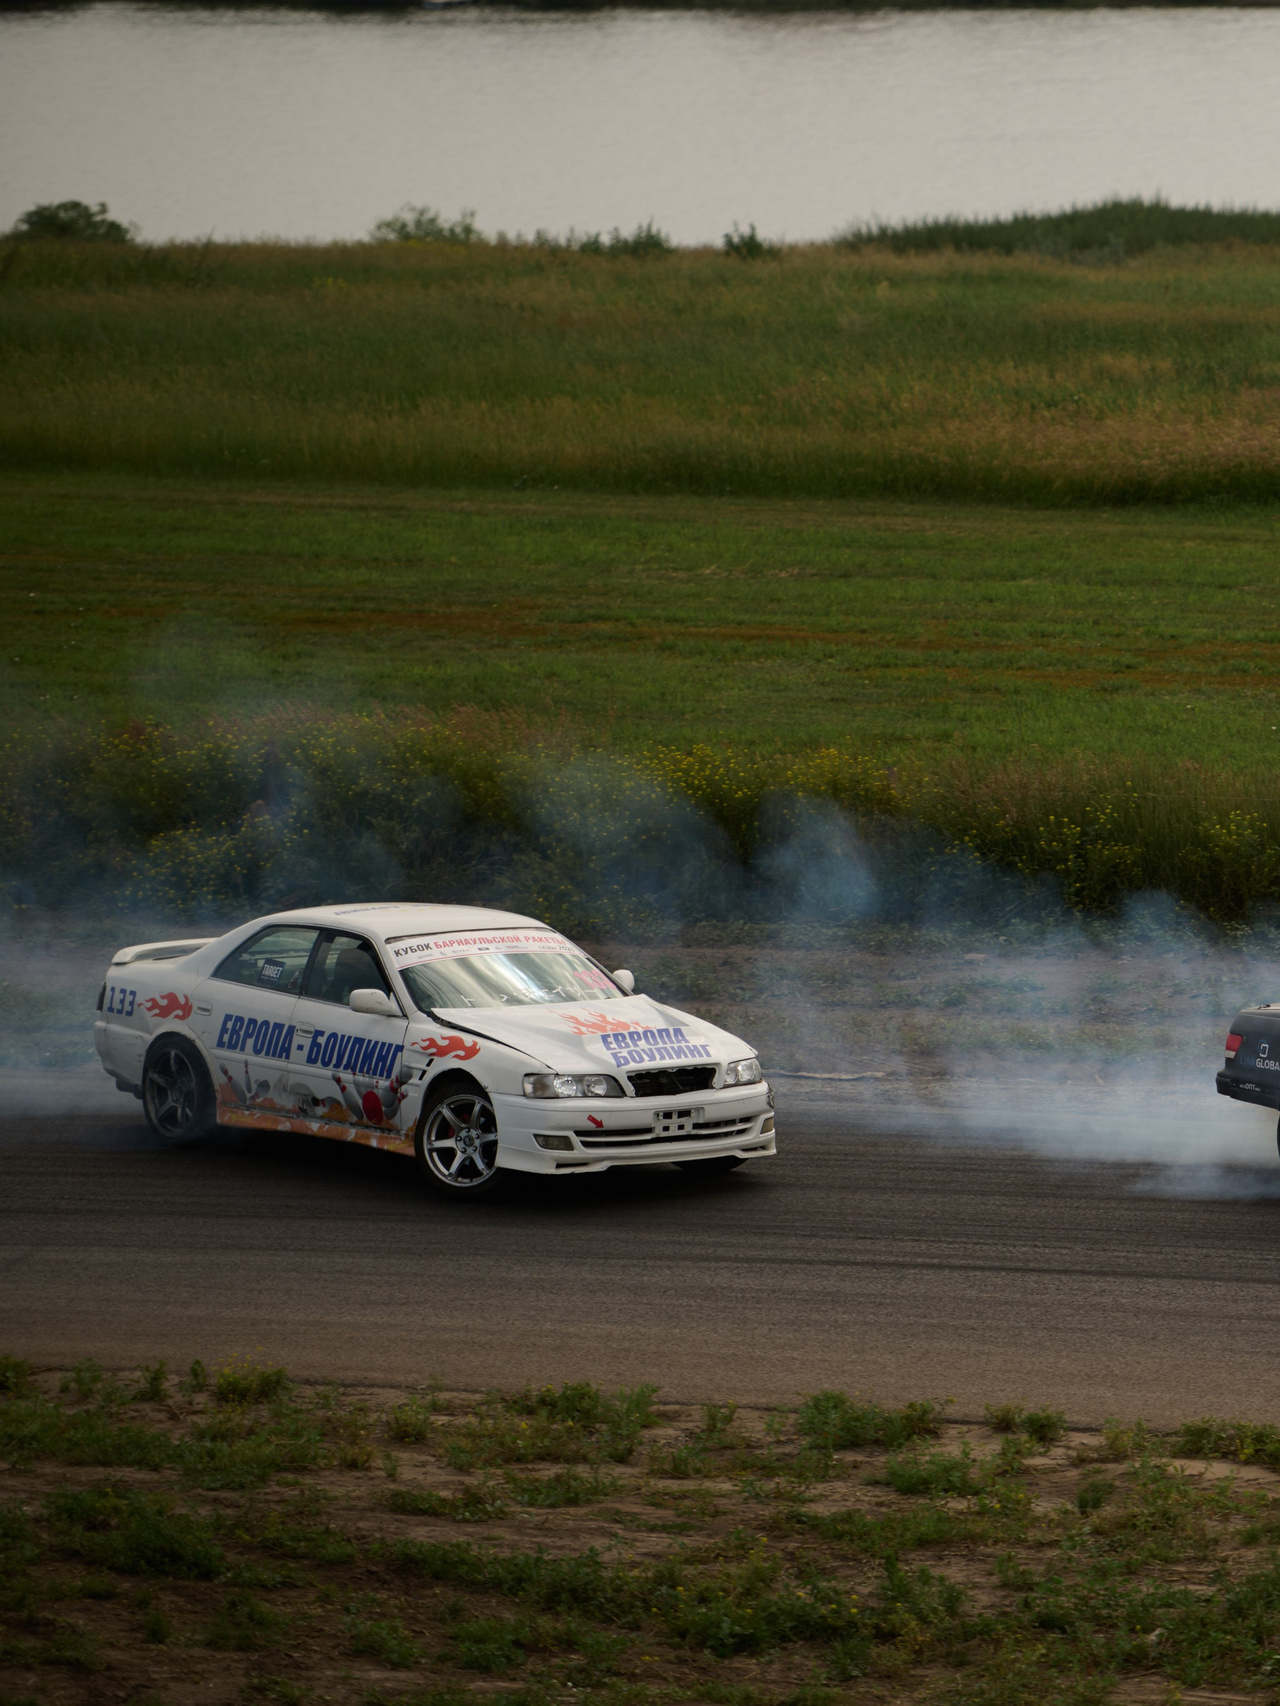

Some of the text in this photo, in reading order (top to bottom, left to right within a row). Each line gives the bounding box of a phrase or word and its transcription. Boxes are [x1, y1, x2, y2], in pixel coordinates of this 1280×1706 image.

[394, 943, 433, 958] КУБОК
[434, 935, 522, 952] БАРНАУЛЬСКОЙ
[524, 936, 567, 946] РАКЕТЫ
[262, 964, 283, 979] TARGET
[107, 986, 137, 1017] 133
[216, 1013, 296, 1060] ЕВРОПА
[306, 1029, 405, 1079] БОУЛИНГ
[600, 1028, 690, 1052] ЕВРОПА
[610, 1044, 712, 1068] БОУЛИНГ
